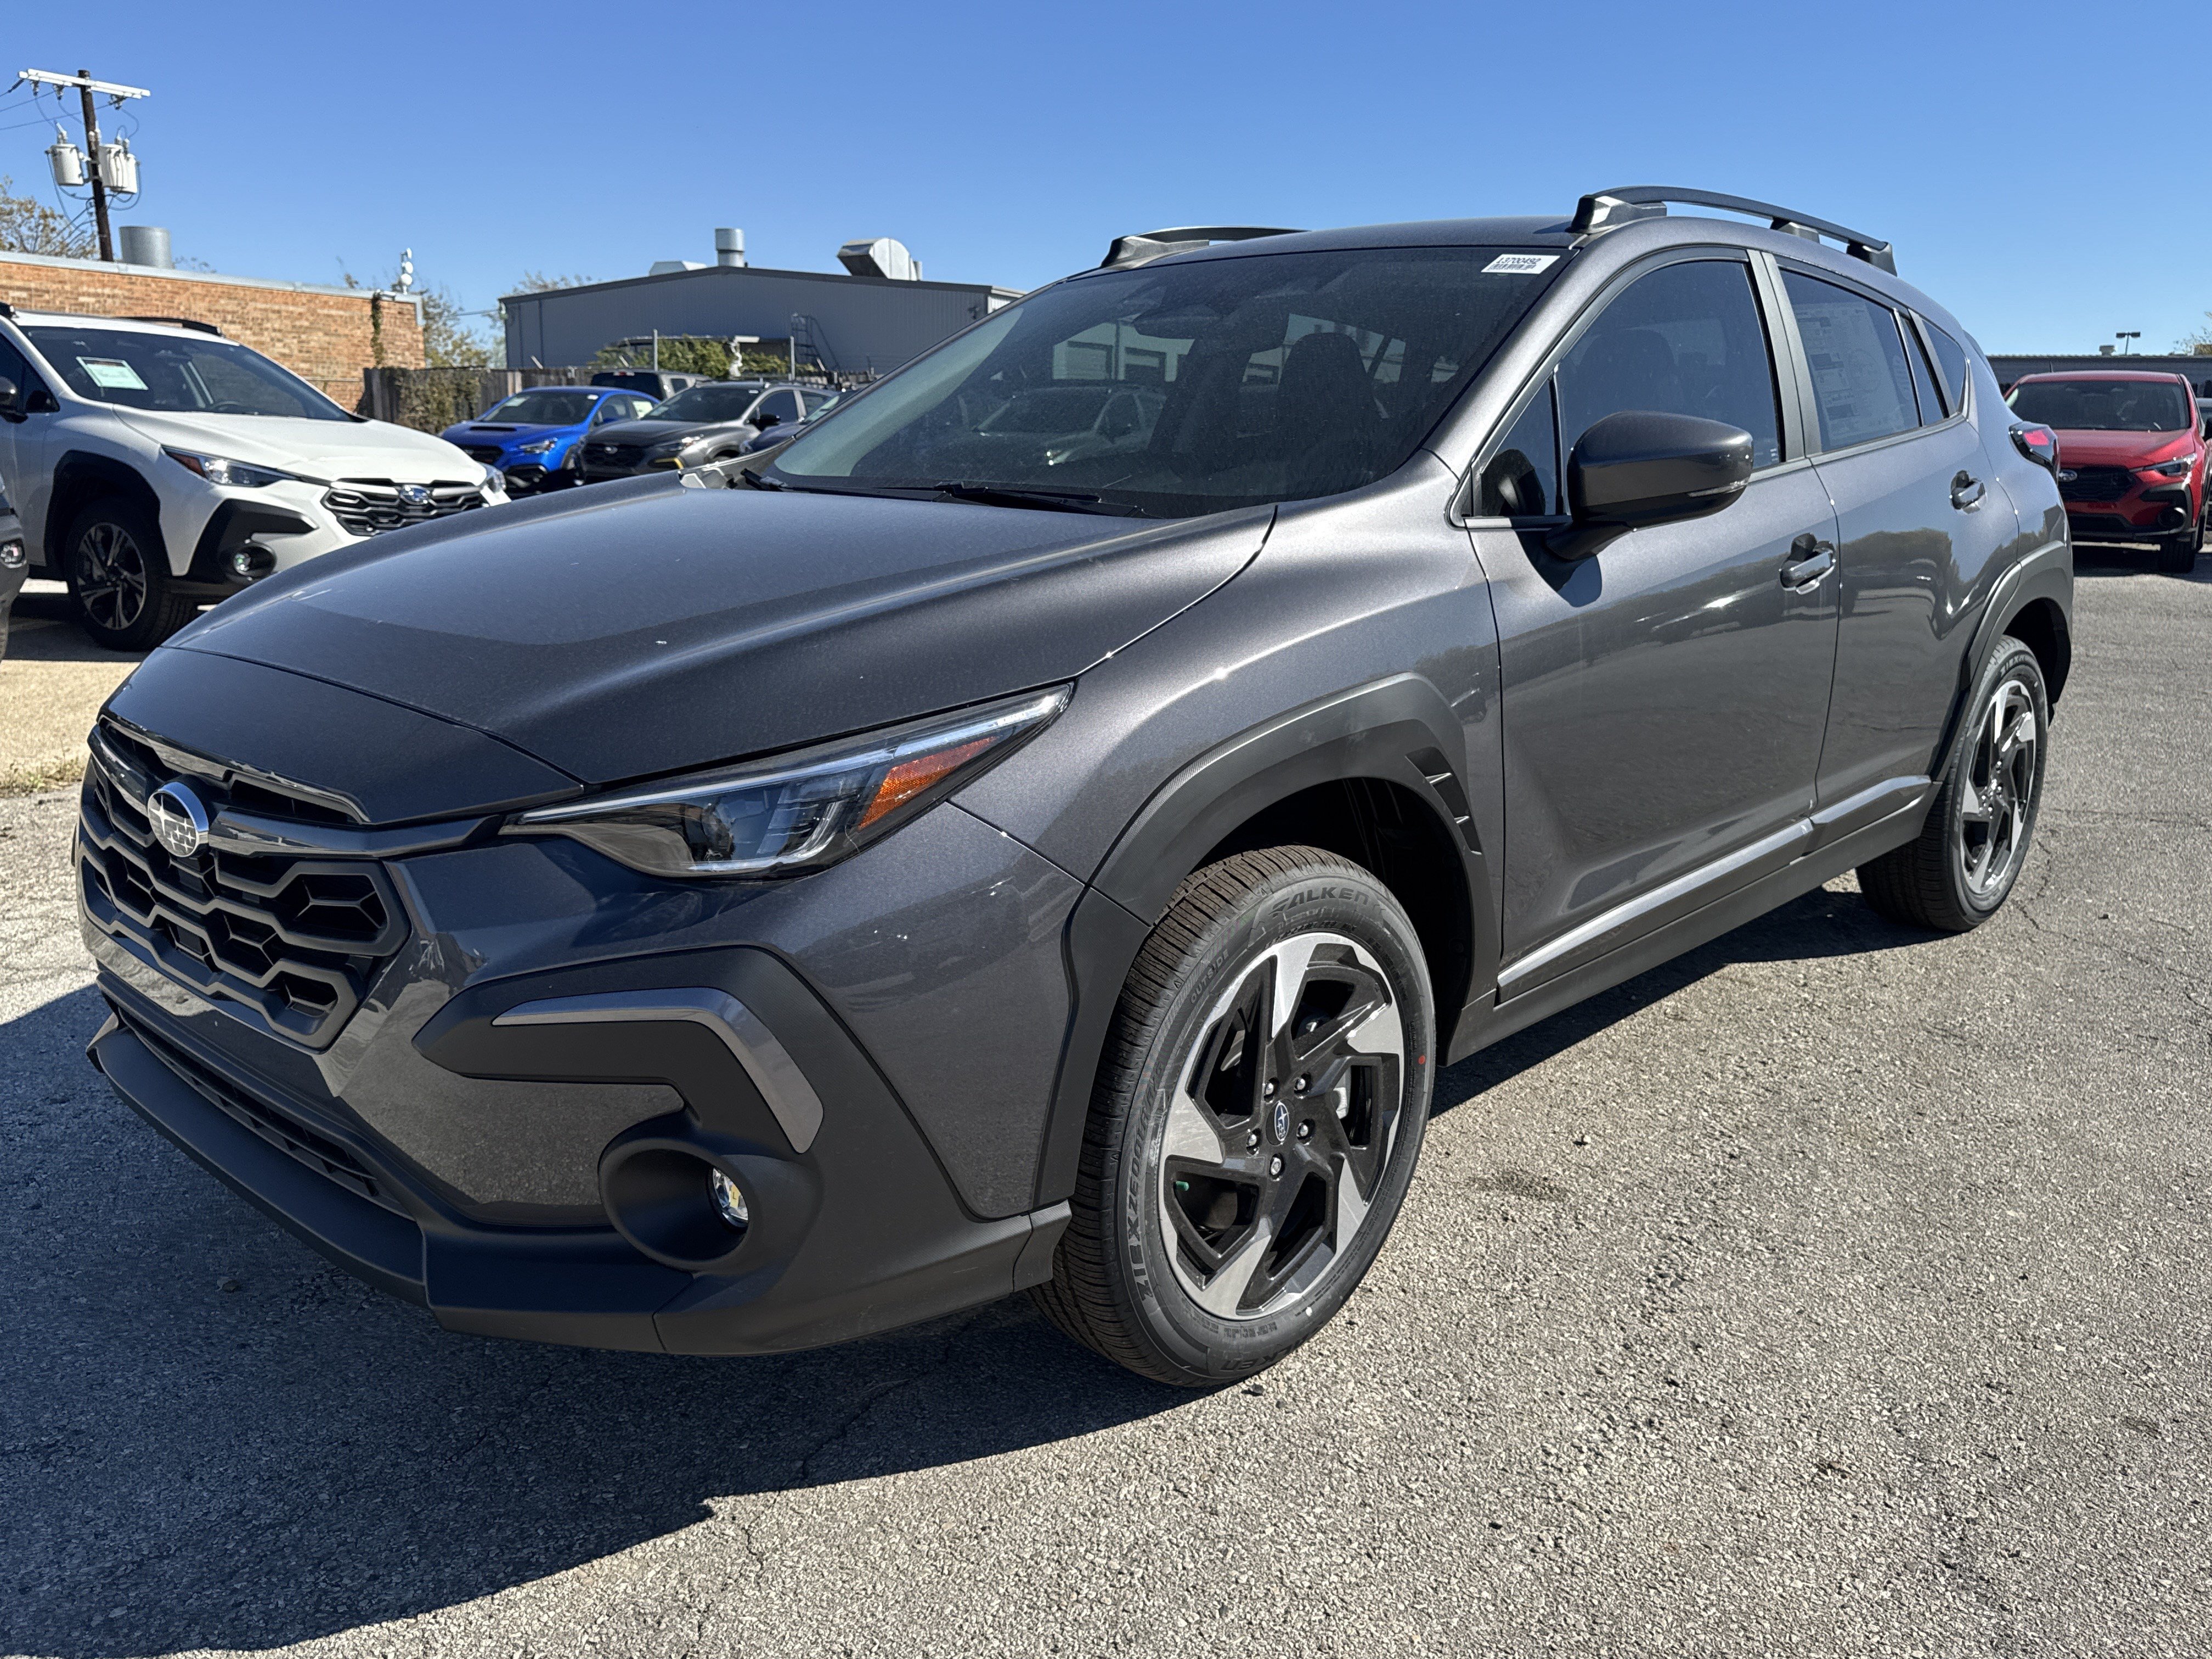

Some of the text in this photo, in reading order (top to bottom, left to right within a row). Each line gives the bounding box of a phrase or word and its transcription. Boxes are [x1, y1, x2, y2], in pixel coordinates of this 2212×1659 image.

[1268, 887, 1370, 918] FALKEN
[1190, 949, 1229, 1004] OUTSIDE
[1128, 1216, 1154, 1301] ZIEX
